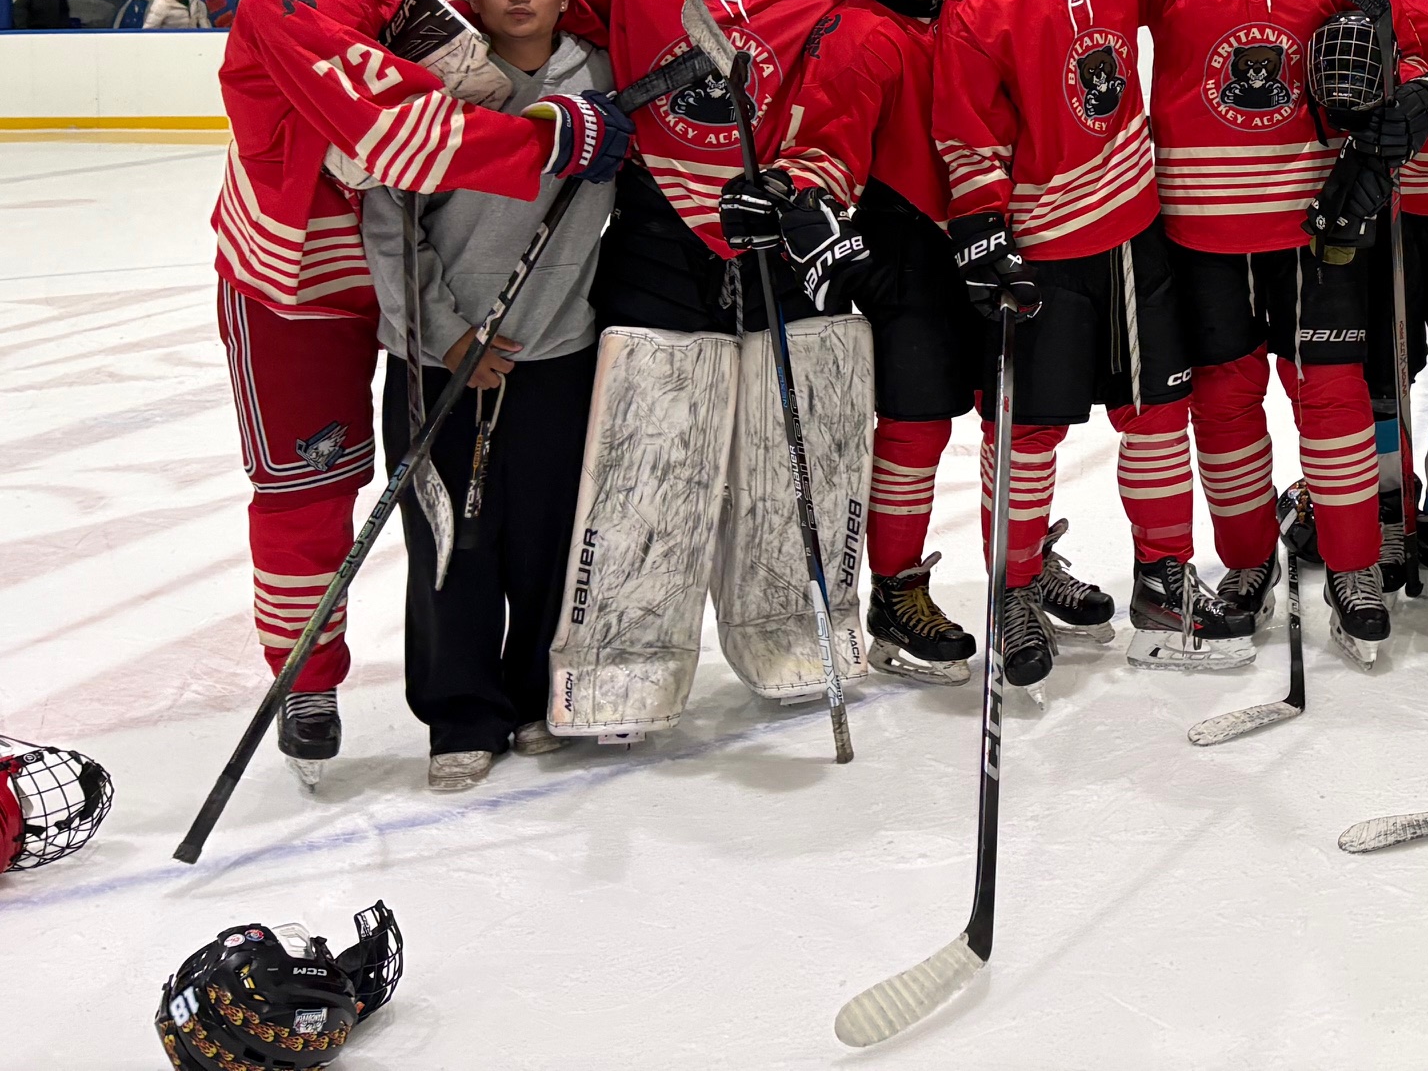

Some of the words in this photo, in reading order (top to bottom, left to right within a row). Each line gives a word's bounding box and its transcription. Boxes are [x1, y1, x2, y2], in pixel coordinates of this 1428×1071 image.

[1211, 27, 1298, 69] BRITANNIA
[312, 43, 404, 101] 72
[1206, 79, 1245, 125] HOCKEY
[1251, 79, 1301, 126] ACADEMY
[804, 236, 864, 301] BAUER
[1300, 329, 1365, 342] BAUER
[844, 498, 862, 587] BAUER
[571, 527, 598, 625] BAUER
[847, 628, 861, 665] MACH
[564, 671, 573, 712] MACH
[293, 967, 327, 976] CCM
